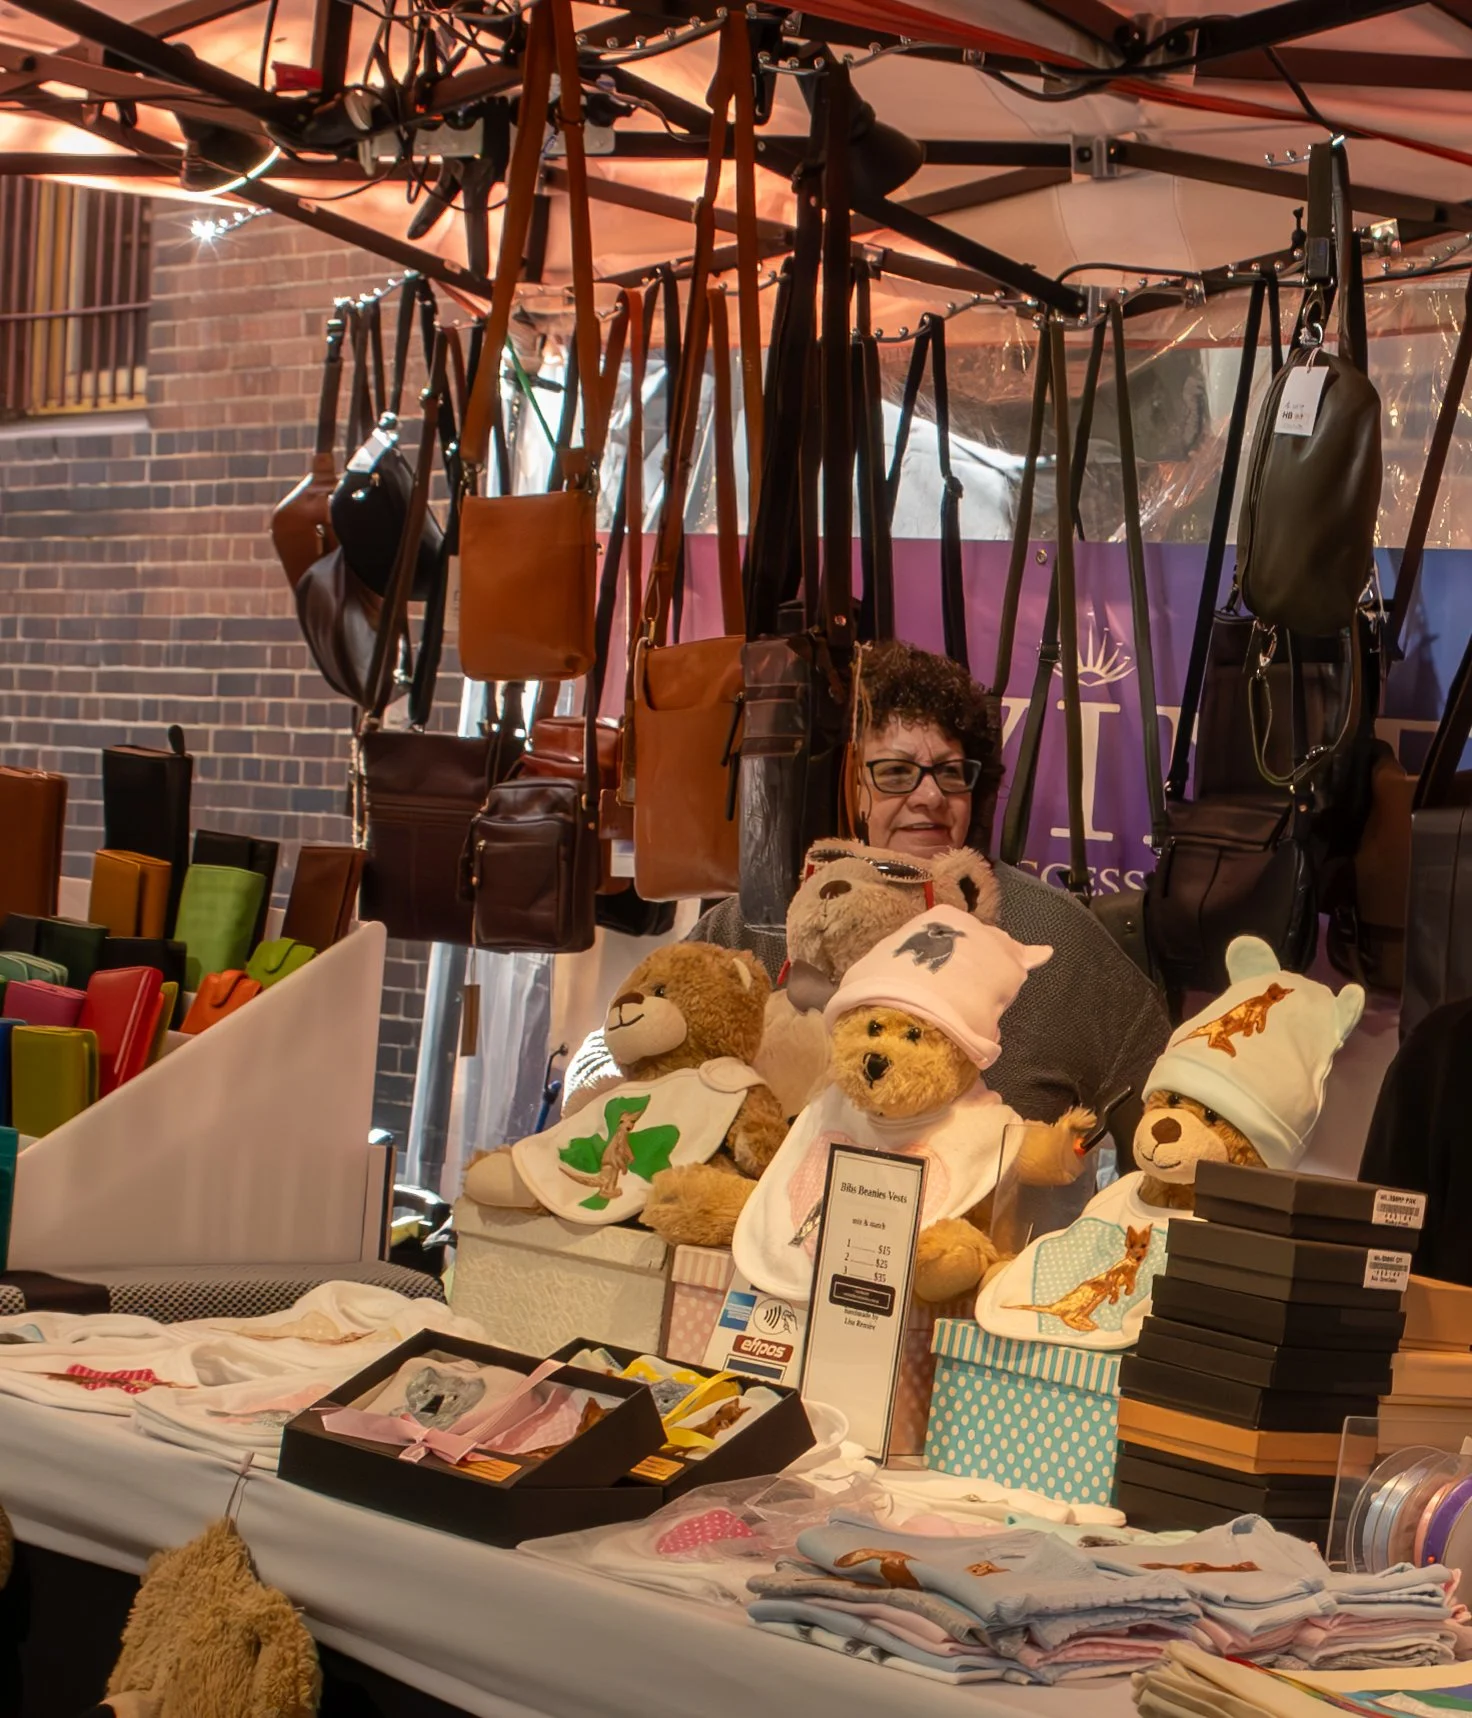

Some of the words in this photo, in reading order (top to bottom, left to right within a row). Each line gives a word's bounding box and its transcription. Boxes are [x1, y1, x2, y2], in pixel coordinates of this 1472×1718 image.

[840, 1182, 857, 1194] Bibs
[857, 1185, 887, 1200] Beanies
[888, 1190, 908, 1204] Vests
[878, 1244, 891, 1256] $15
[844, 1252, 850, 1261] 2
[875, 1258, 888, 1269] $25
[843, 1265, 848, 1275] 3
[874, 1272, 887, 1283] $35
[740, 1337, 786, 1359] eftpos
